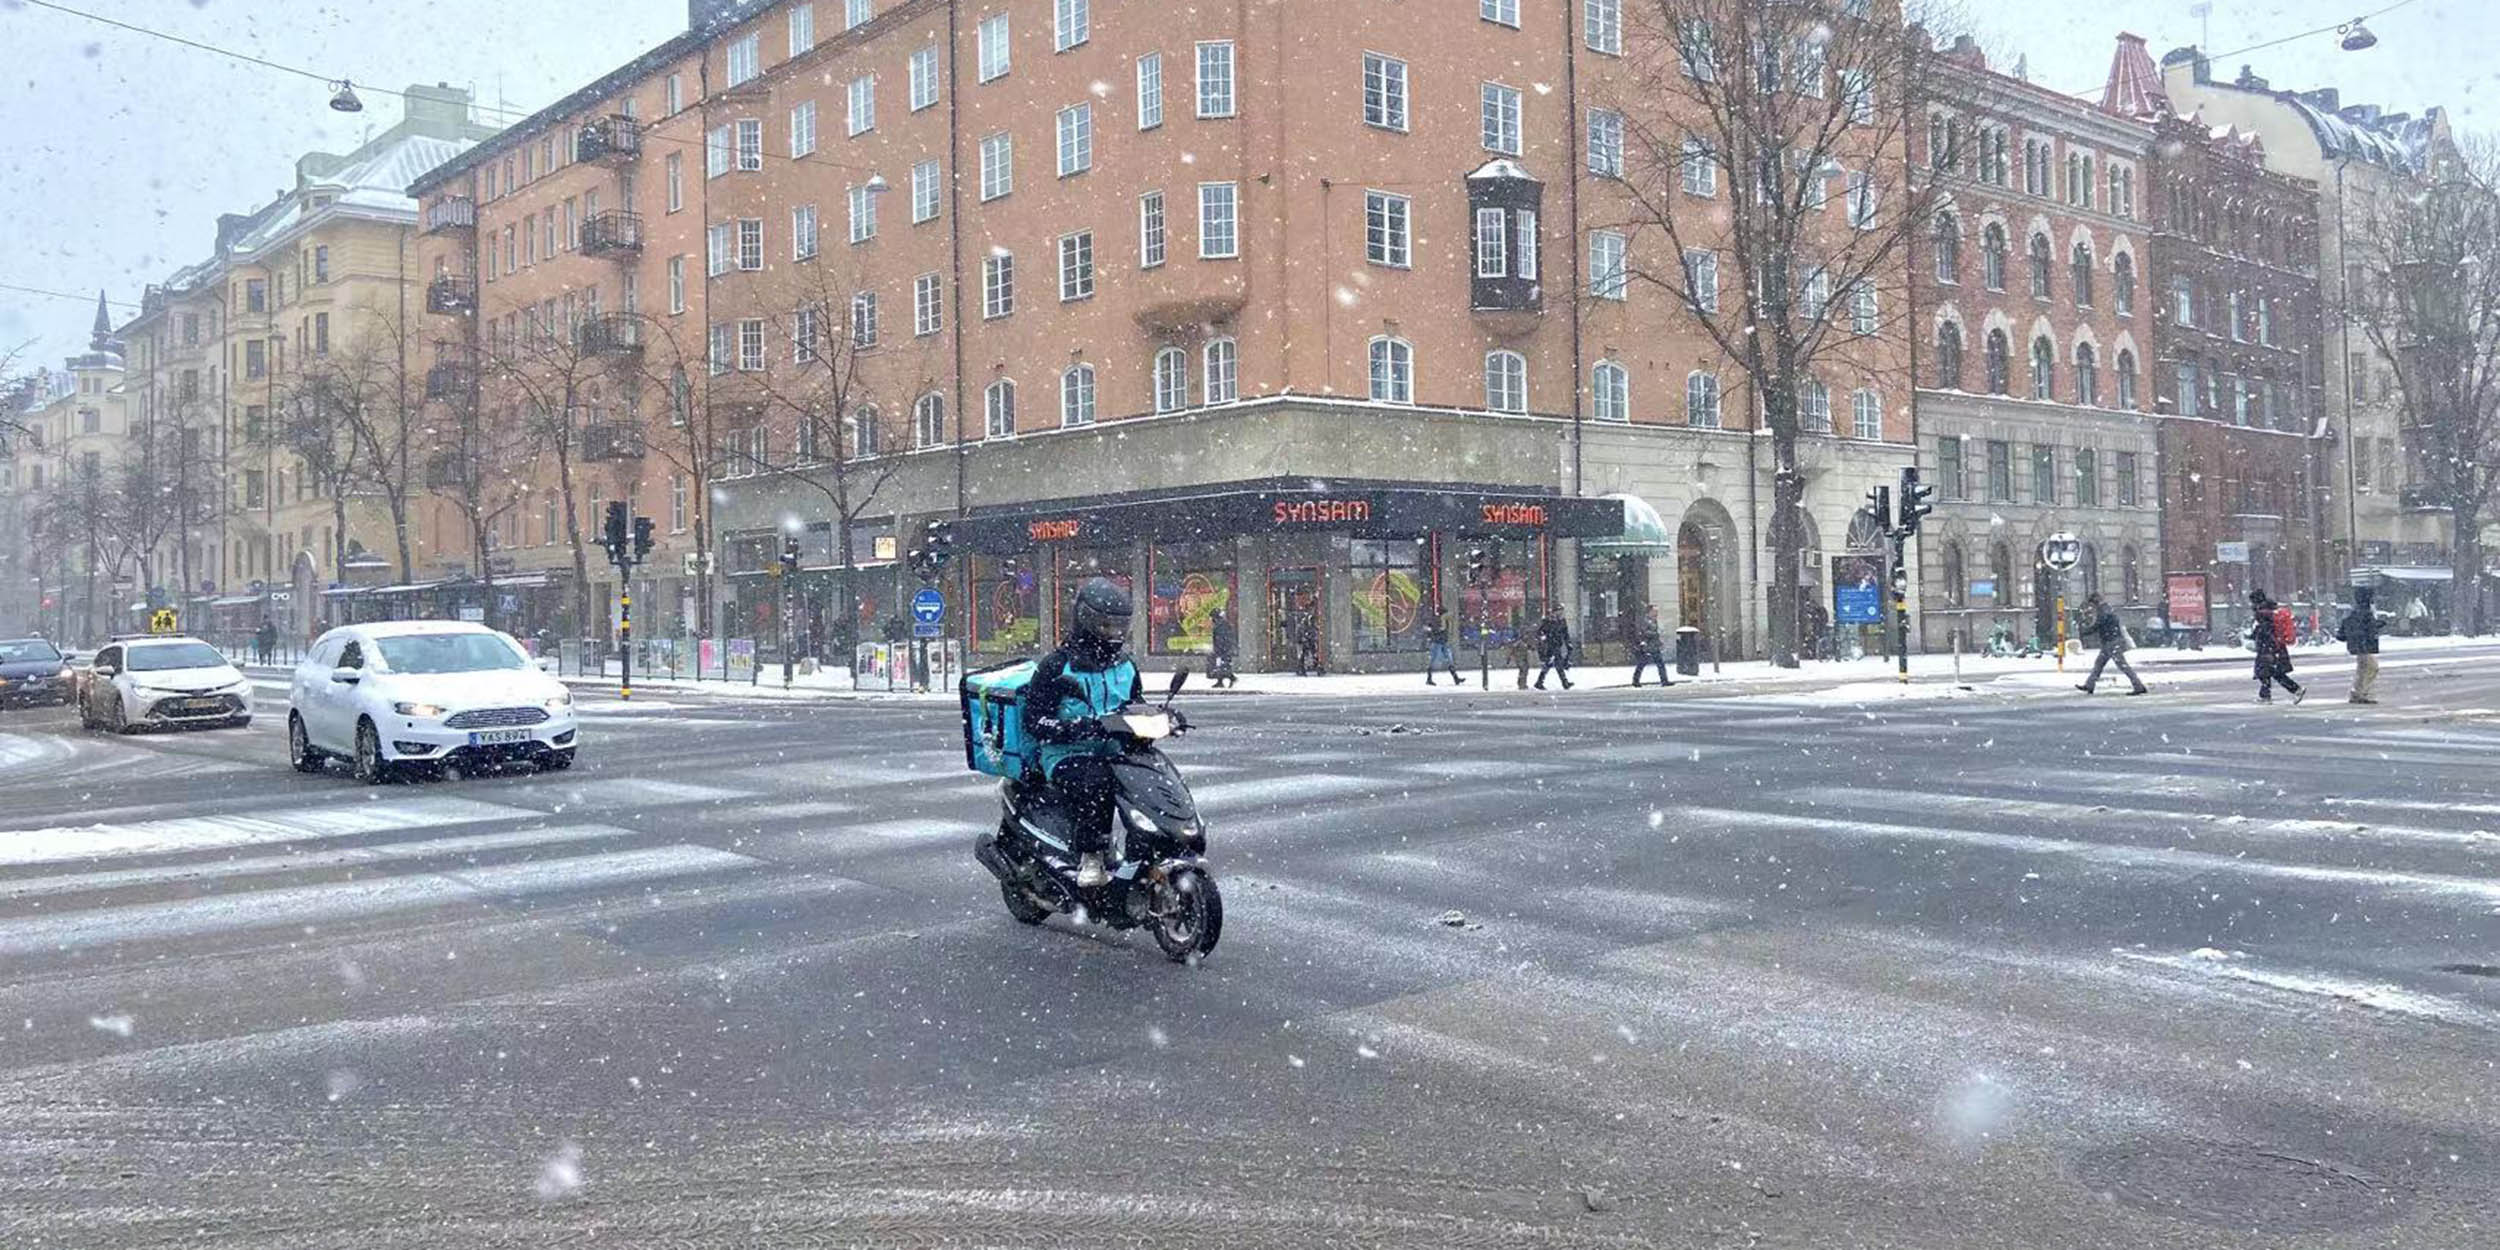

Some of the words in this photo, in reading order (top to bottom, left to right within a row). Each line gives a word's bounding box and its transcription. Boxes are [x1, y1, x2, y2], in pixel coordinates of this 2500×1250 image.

[1275, 500, 1369, 521] SYNSAM
[1482, 504, 1544, 524] SYNSAM
[1028, 520, 1079, 540] SYNSAM
